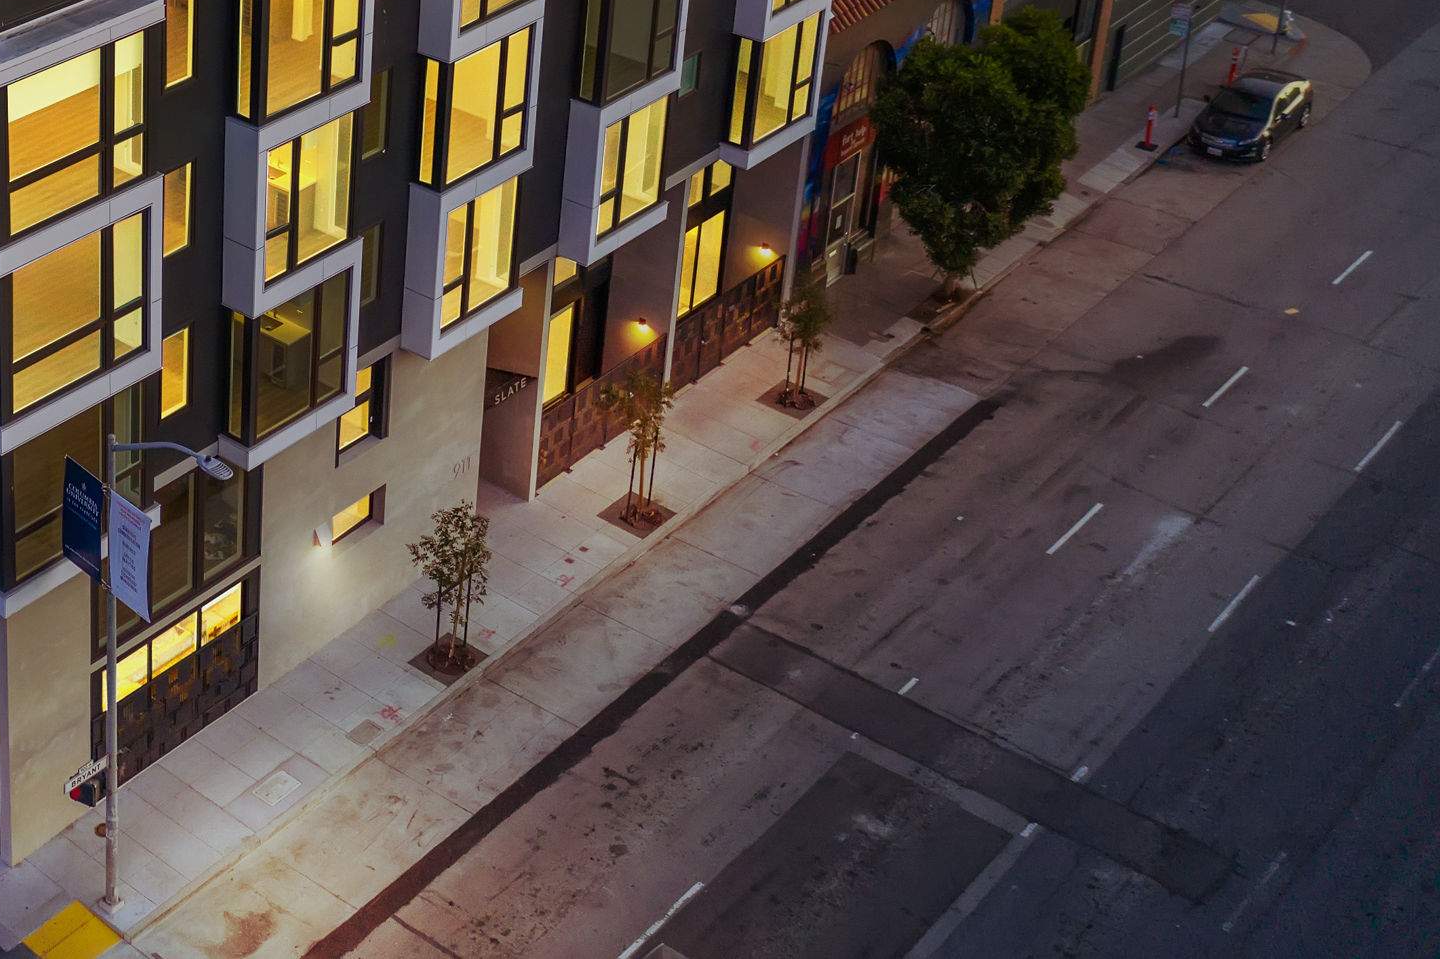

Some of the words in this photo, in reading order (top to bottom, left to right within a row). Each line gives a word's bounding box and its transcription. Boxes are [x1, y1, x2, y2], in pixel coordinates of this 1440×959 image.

[494, 377, 527, 405] SLATE
[453, 456, 471, 479] 911
[66, 488, 100, 518] UNIVERSITY
[68, 483, 98, 509] COLUMBIA
[71, 763, 101, 788] BRYANT
